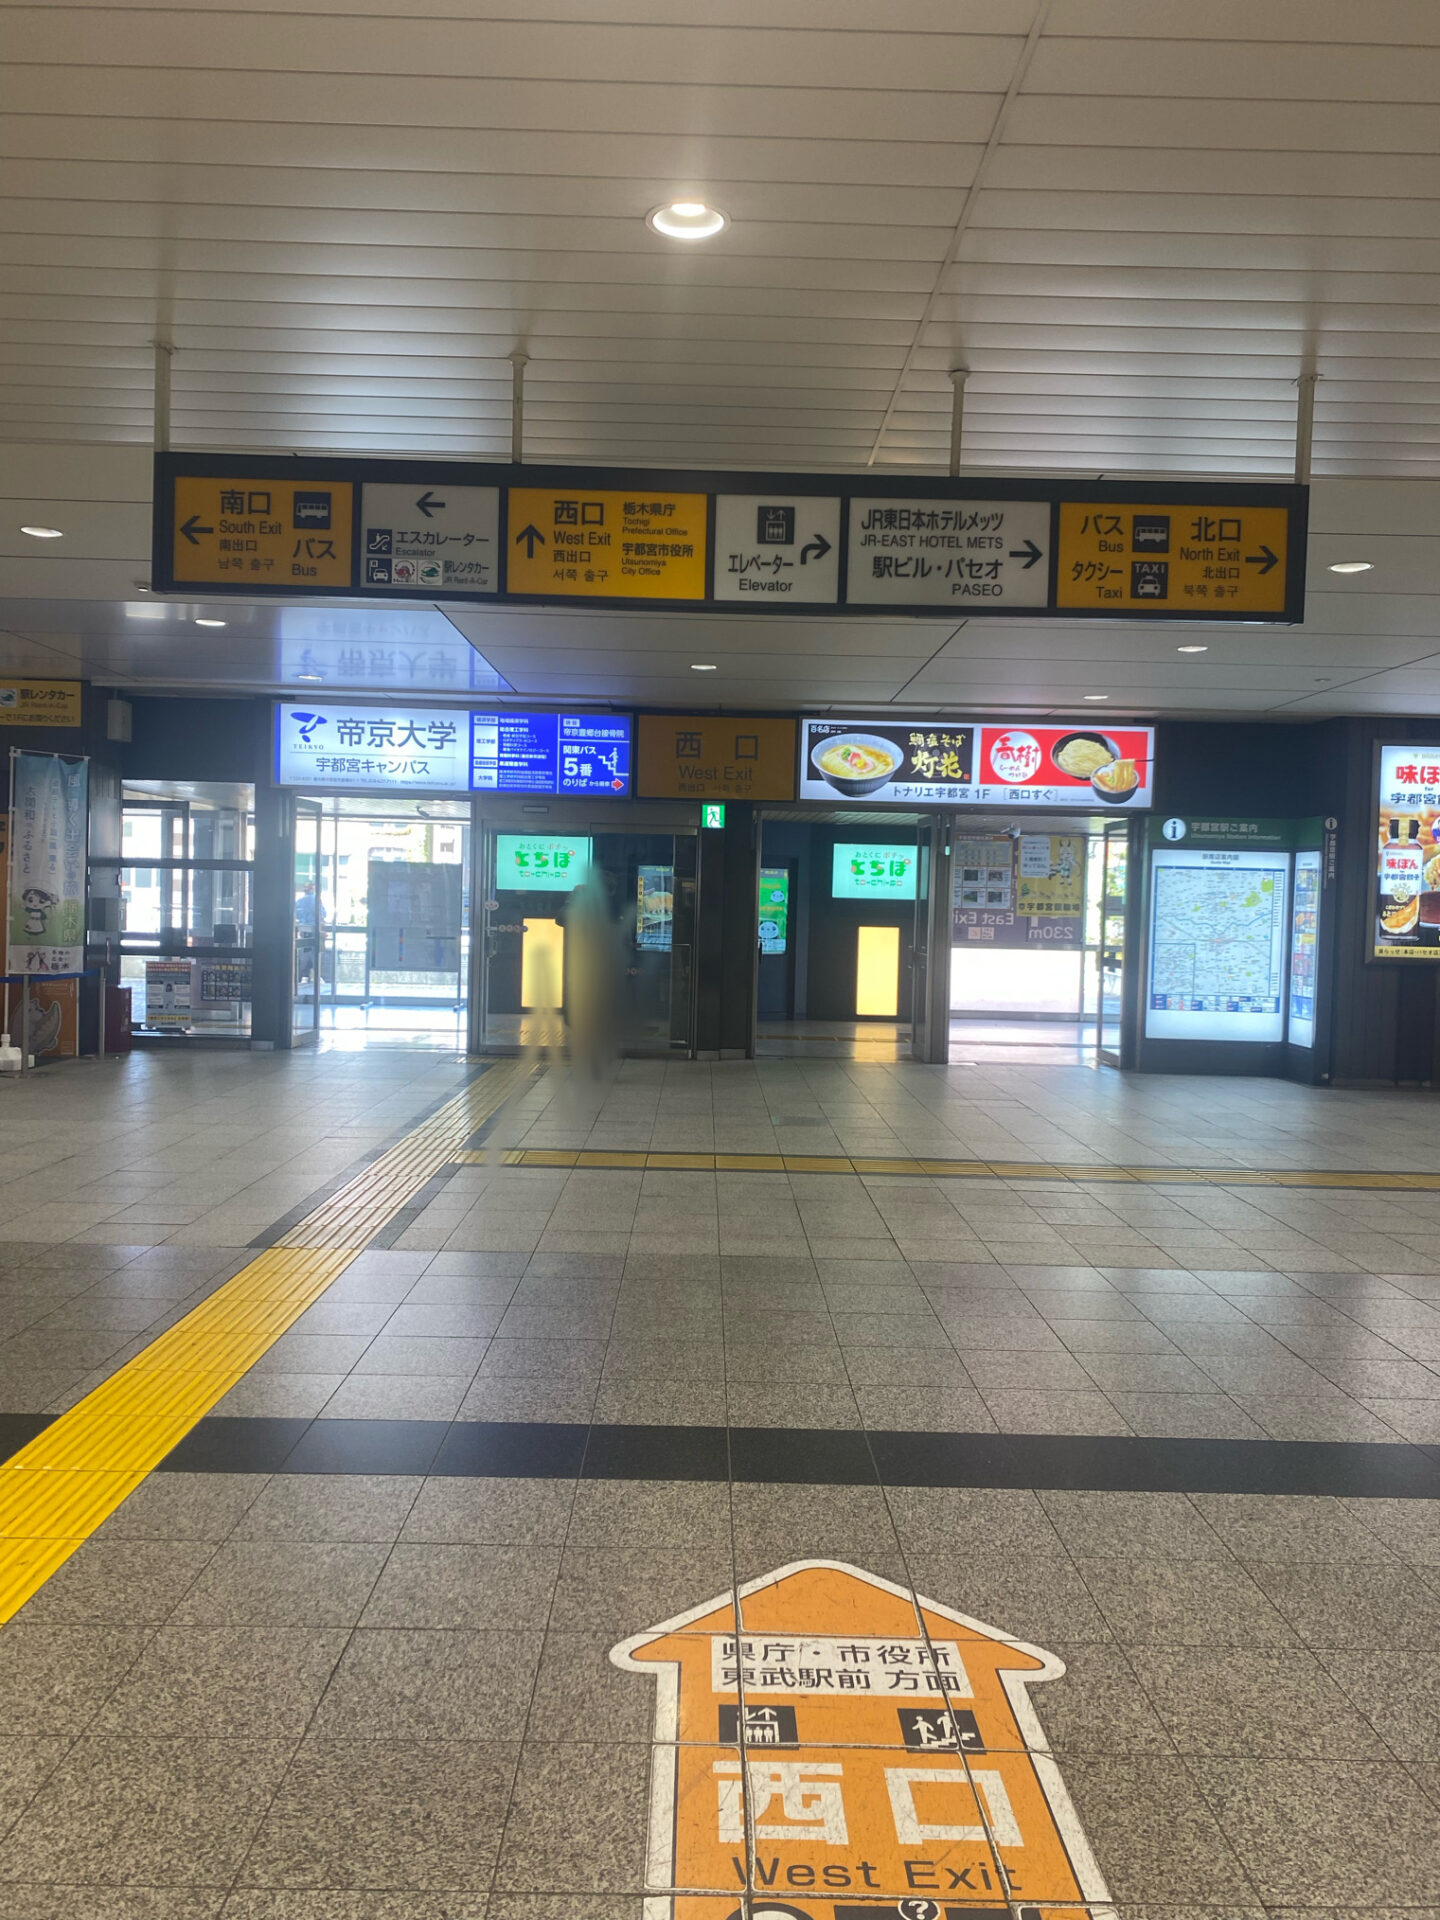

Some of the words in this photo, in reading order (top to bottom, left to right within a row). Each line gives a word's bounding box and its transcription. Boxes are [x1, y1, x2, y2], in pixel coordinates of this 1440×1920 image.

[219, 490, 271, 515] 南口
[623, 502, 676, 517] 栃木県庁
[553, 501, 604, 526] 西口
[861, 509, 1004, 532] JR東日本ホテルメッツ
[219, 521, 255, 535] South
[259, 521, 282, 536] Exit
[623, 517, 650, 528] Tochigi
[1081, 514, 1124, 536] バス
[1190, 517, 1242, 542] 北口
[396, 531, 489, 546] エスカレーター
[553, 531, 585, 546] West
[589, 532, 611, 547] Exit
[622, 526, 664, 537] Prefectural
[665, 527, 689, 537] Office
[219, 539, 258, 553] 南出口
[860, 534, 917, 547] JR-EAST
[919, 535, 964, 548] HOTEL
[967, 536, 1003, 549] METS
[1099, 540, 1124, 553] Bus
[293, 539, 336, 561] バス
[395, 547, 436, 557] Escalator
[553, 550, 591, 563] 西出口
[622, 542, 694, 558] 宇都宮市役所
[1180, 548, 1216, 560] North
[1218, 548, 1240, 562] Exit
[217, 557, 243, 571] 남쪽
[249, 558, 275, 572] 출구
[292, 563, 317, 577] Bus
[444, 560, 489, 574] 駅レンタカー
[621, 558, 667, 568] Utsunomiya
[728, 554, 794, 575] エレベーター
[872, 557, 1003, 579] 駅ビル・パセオ
[1133, 563, 1166, 574] TAXI
[553, 569, 577, 582] 서쪽
[584, 569, 609, 583] 출구
[621, 567, 637, 578] City
[638, 568, 661, 577] Office
[1072, 561, 1123, 582] タクシー
[1202, 566, 1240, 580] 北出口
[739, 578, 793, 592] Elevator
[952, 584, 1003, 597] PASEO
[1096, 586, 1123, 599] Taxi
[1183, 585, 1210, 598] 북쪽
[1213, 585, 1240, 599] 출구
[20, 688, 75, 700] 駅レンタカー
[337, 718, 457, 750] 帝京大学
[908, 732, 967, 748] 鯛塩そば
[563, 745, 597, 755] 関東バス
[675, 732, 759, 760] 西口
[316, 757, 430, 775] 宇都宮キャンパス
[564, 757, 593, 777] 5番
[911, 750, 964, 779] 灯花
[678, 765, 717, 780] West
[723, 766, 753, 781] Exit
[563, 778, 588, 787] のりば
[894, 786, 970, 799] トナリエ宇都宮
[975, 788, 991, 799] 1F
[1391, 792, 1440, 805] 宇都宮
[1191, 822, 1258, 833] 宇都宮駅ご案内
[519, 842, 546, 850] おとくに
[515, 850, 576, 868] とちぽ
[1386, 858, 1418, 870] 味ぽん
[851, 858, 912, 877] とちぽ
[721, 1642, 951, 1668] 県庁・市役所
[720, 1665, 872, 1691] 東武駅前
[886, 1668, 960, 1693] 方面
[712, 1760, 1025, 1848] 西口
[731, 1856, 881, 1889] West
[903, 1860, 1023, 1893] Exit
